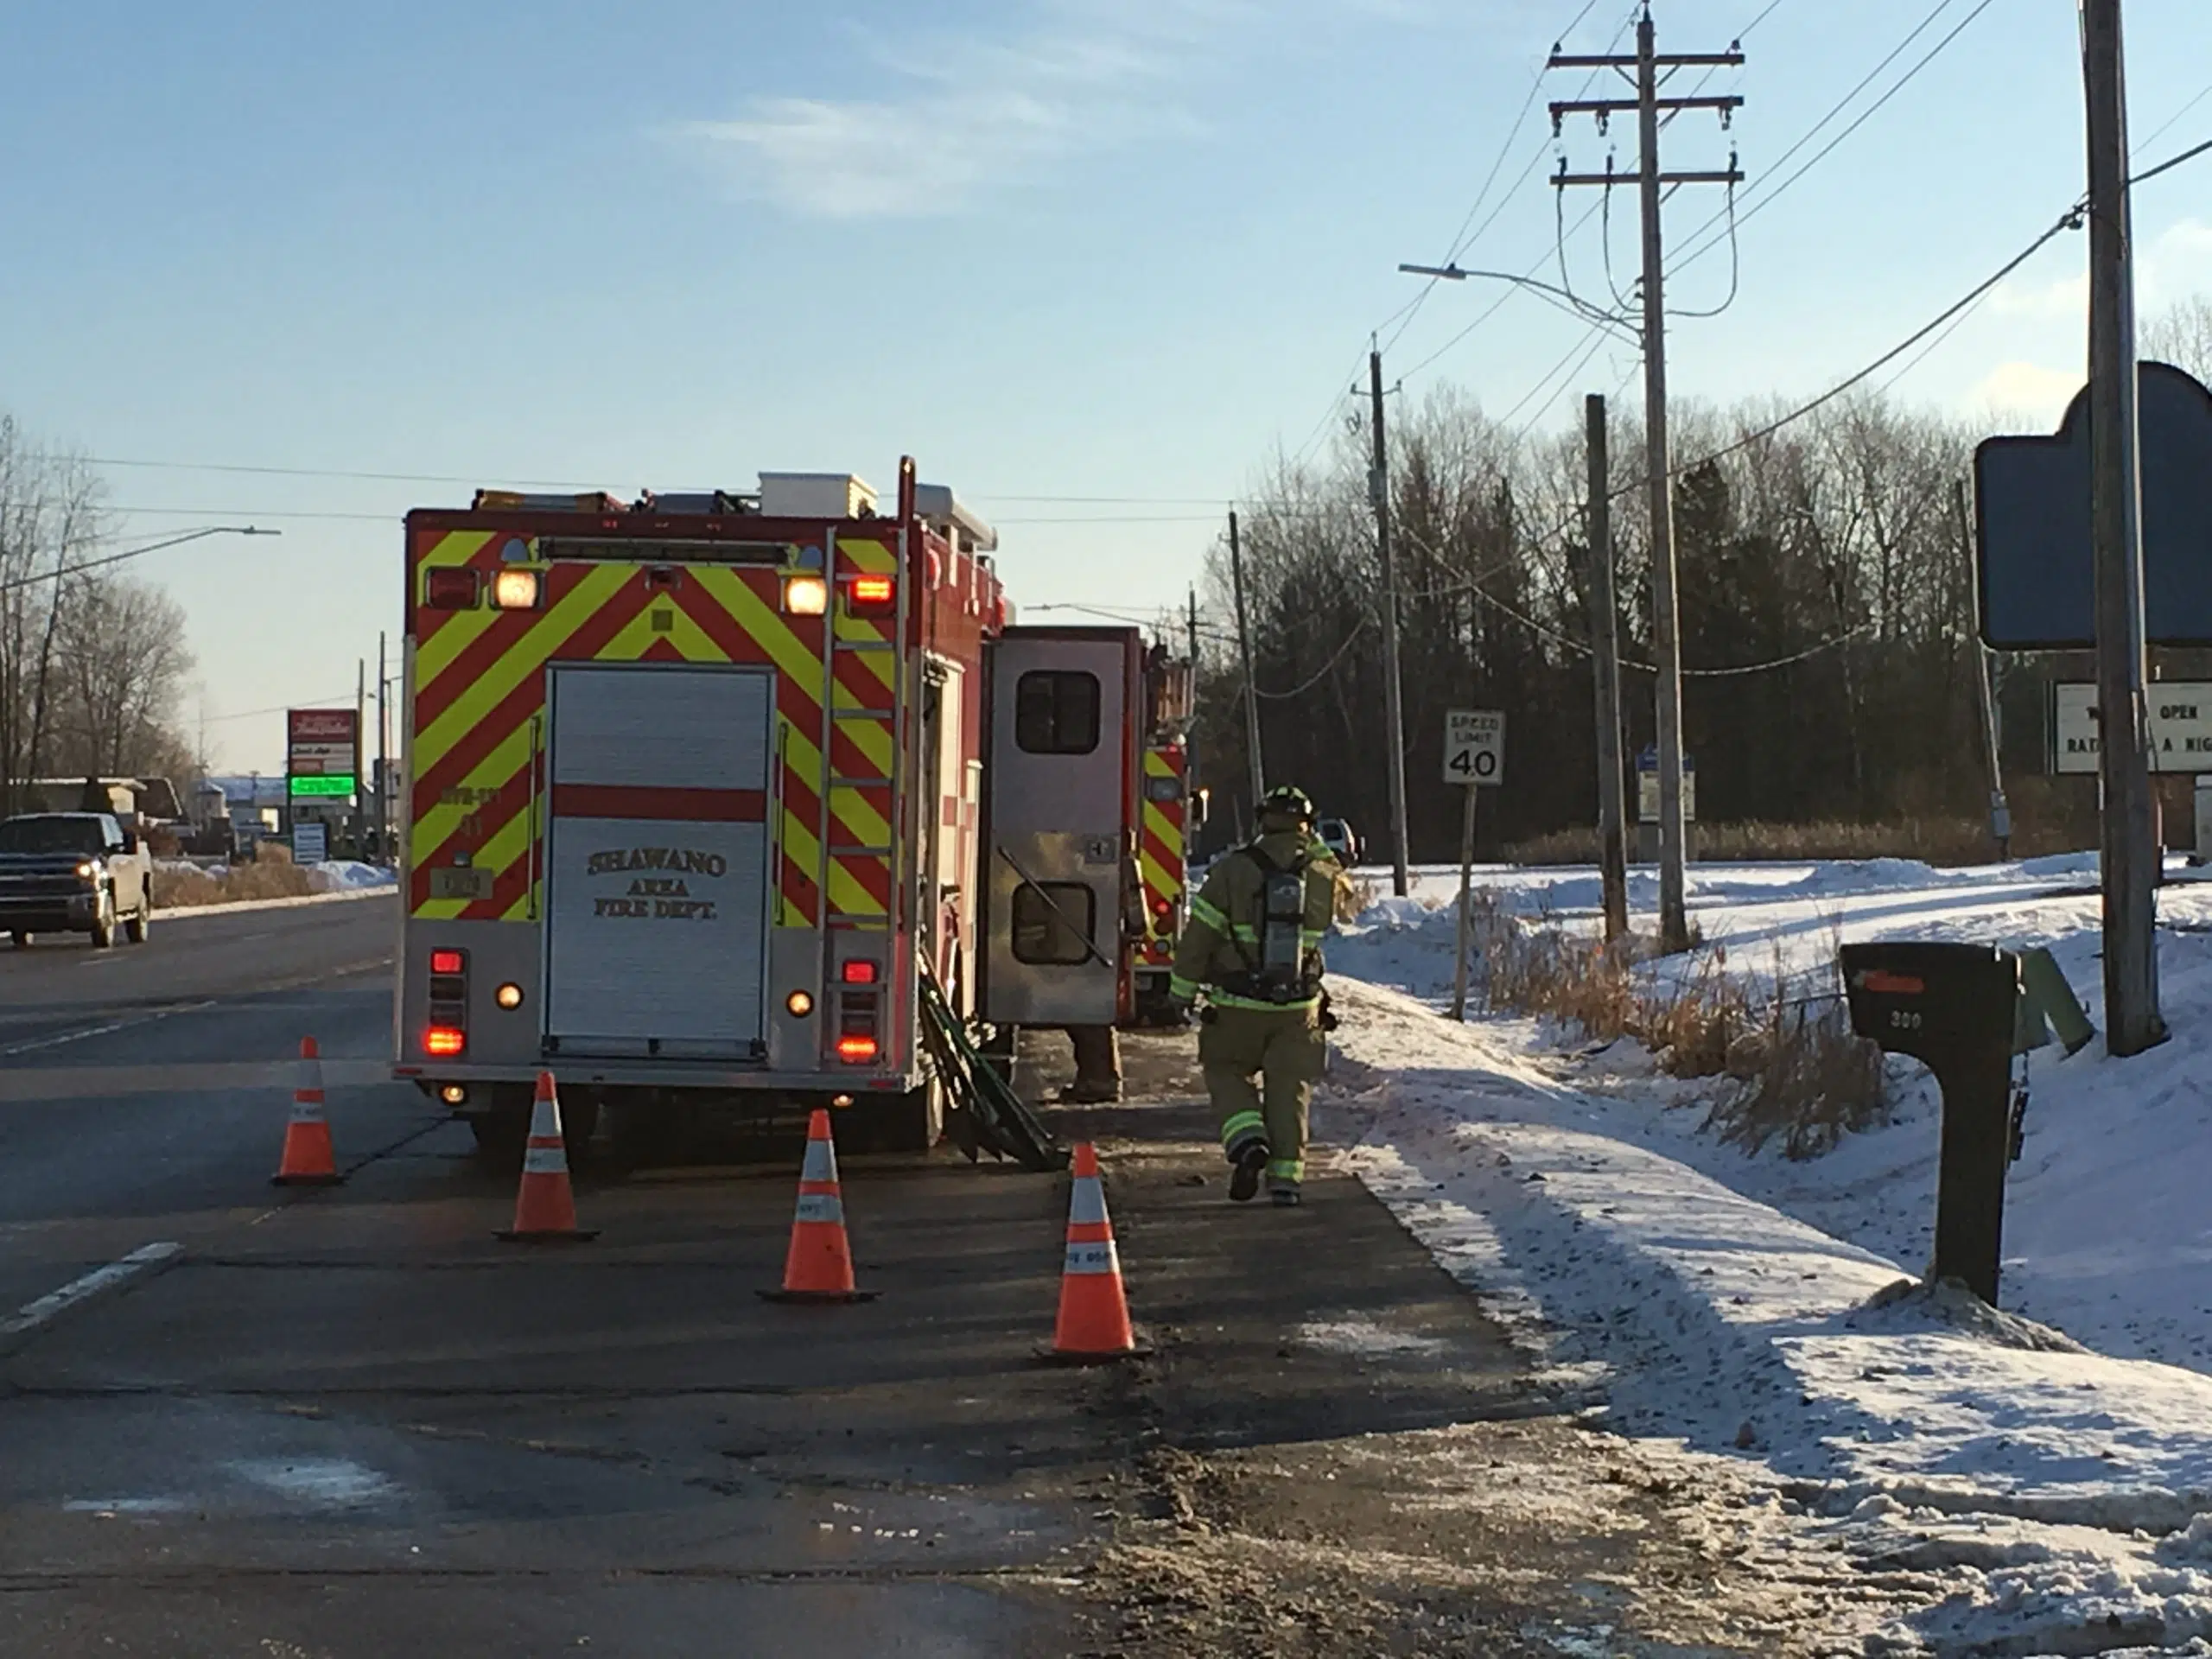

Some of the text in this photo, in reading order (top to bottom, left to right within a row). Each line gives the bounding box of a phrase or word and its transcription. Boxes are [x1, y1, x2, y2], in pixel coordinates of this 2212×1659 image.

[2159, 704, 2198, 720] OPEN
[1454, 731, 1492, 743] LIMIT
[2067, 737, 2100, 753] RAT
[2162, 737, 2173, 752] A
[1449, 748, 1497, 777] 40
[587, 847, 728, 878] SHAWANO
[626, 878, 690, 897] AREA
[594, 897, 718, 919] FIRE DEPT.
